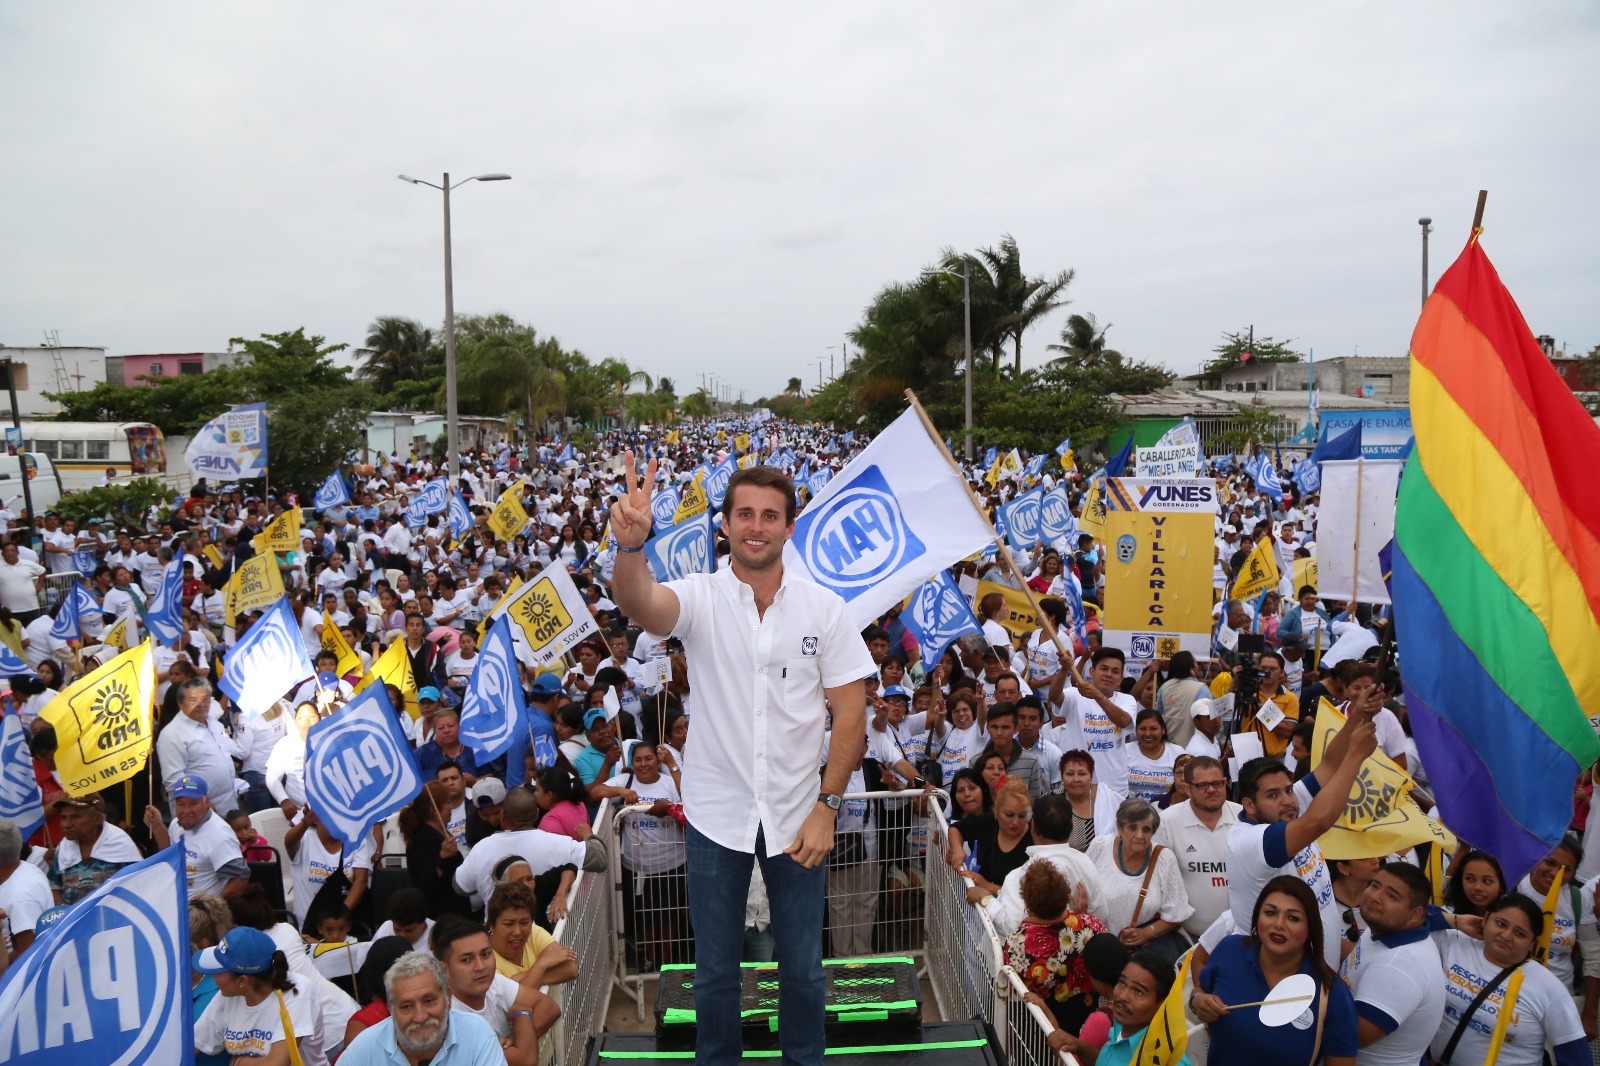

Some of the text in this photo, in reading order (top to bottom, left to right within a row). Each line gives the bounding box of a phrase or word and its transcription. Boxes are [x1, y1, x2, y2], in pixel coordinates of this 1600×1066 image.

[1327, 418, 1412, 429] CASA DE ENLAC
[1139, 446, 1196, 463] CABALLERIZAS
[1360, 446, 1379, 454] ASAS
[1148, 463, 1176, 478] MIGUEL
[1177, 478, 1200, 486] ÁNGEL
[1137, 485, 1212, 509] YUNES
[1148, 516, 1167, 627] VILLARICA
[1135, 641, 1151, 653] PAN
[1086, 741, 1114, 752] YUNES
[1129, 774, 1167, 783] VERACRUZ
[1130, 769, 1175, 777] RESCATEMOS
[1187, 861, 1227, 873] SIEM
[1450, 963, 1508, 997] RESCATM
[1446, 969, 1502, 1004] VERACUZ
[1445, 984, 1497, 1015] AGÁMSLO
[225, 1028, 273, 1041] ESCATEMO
